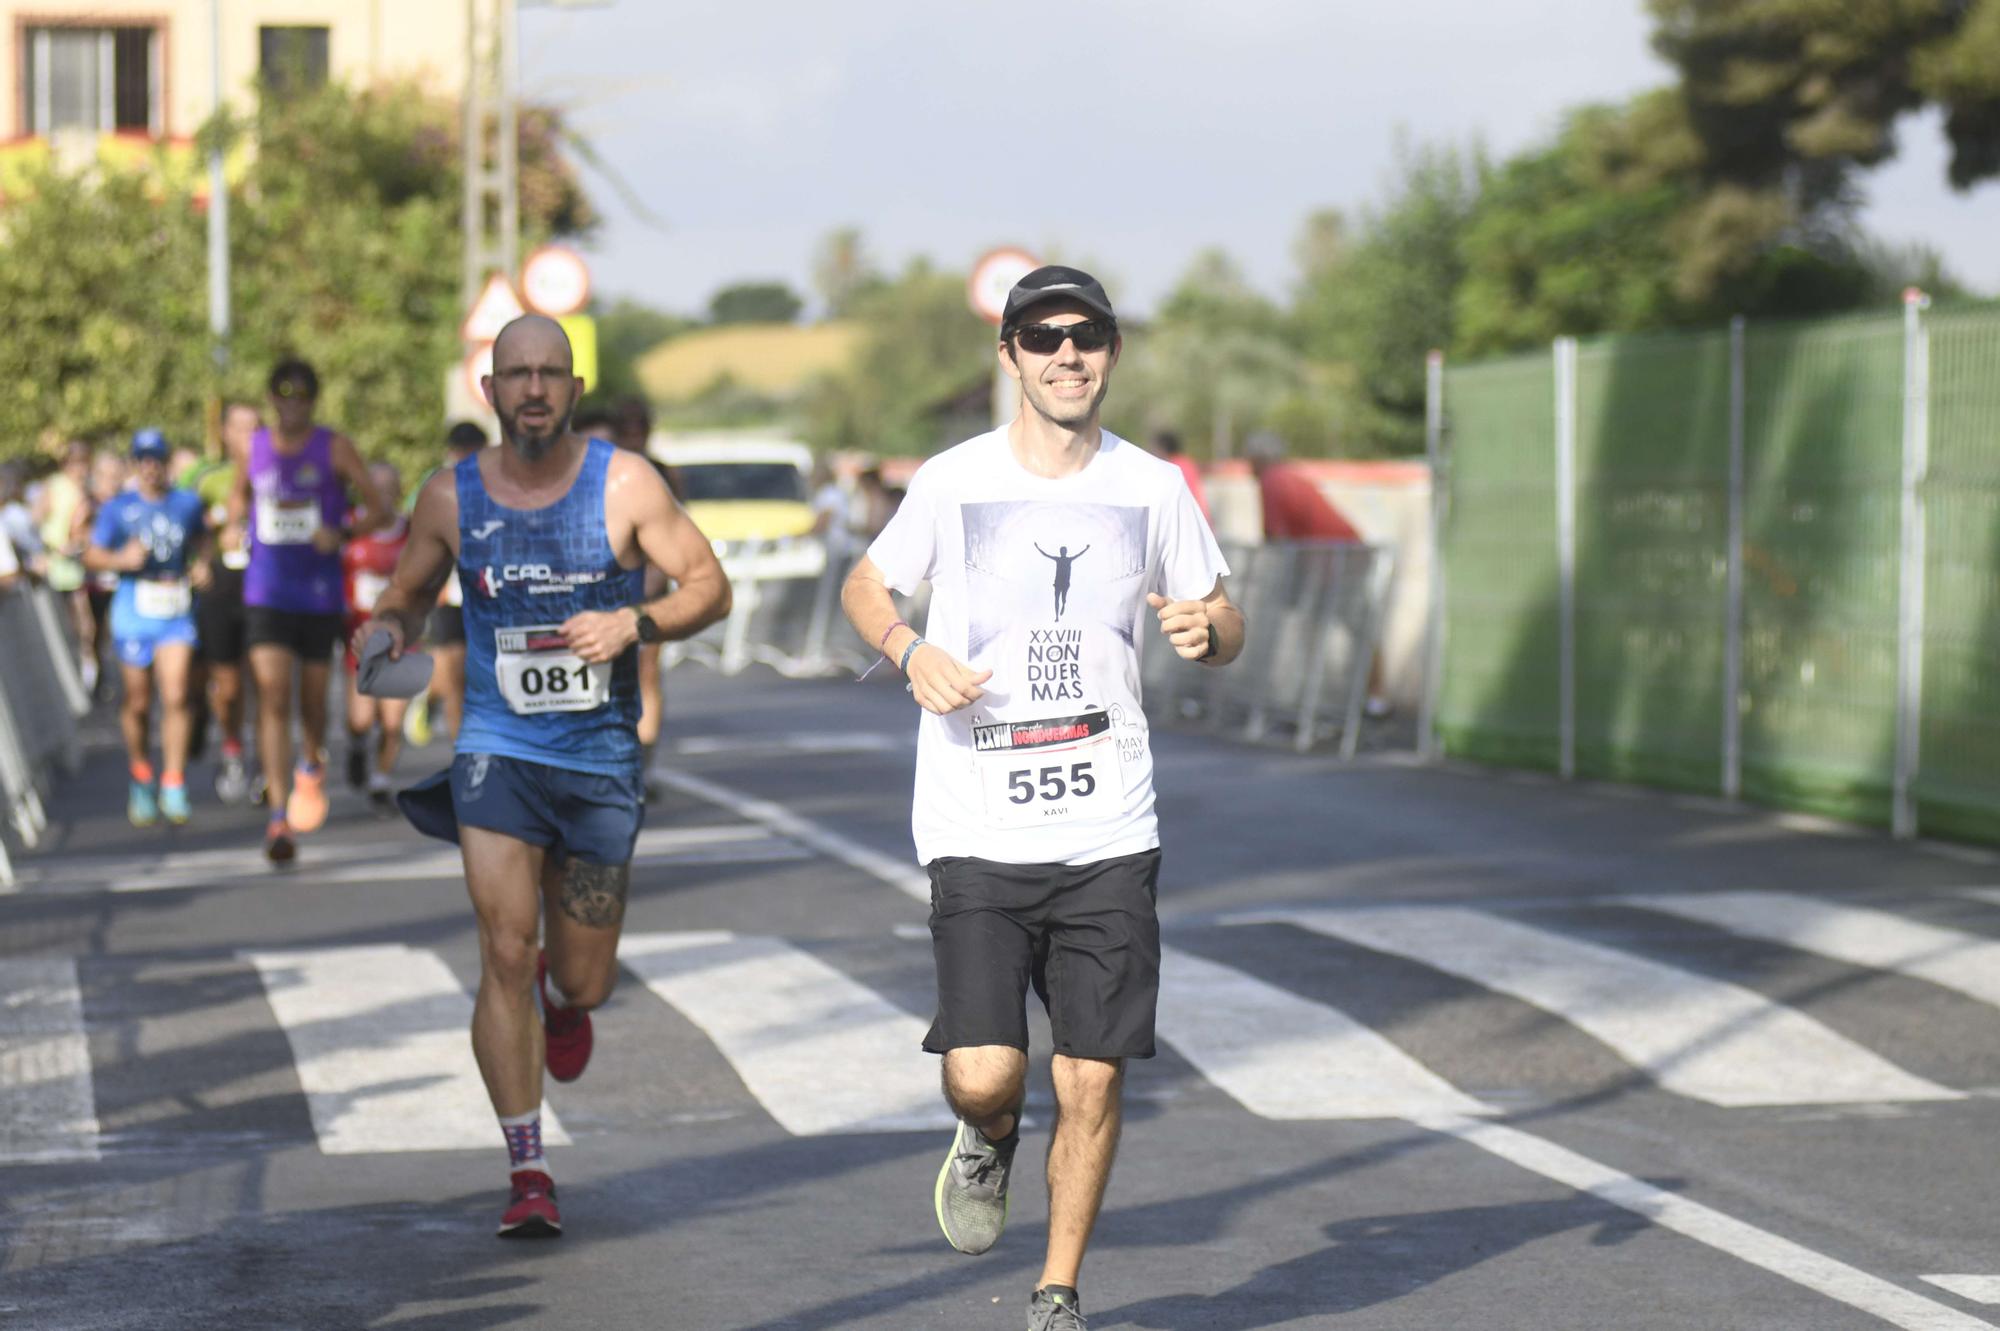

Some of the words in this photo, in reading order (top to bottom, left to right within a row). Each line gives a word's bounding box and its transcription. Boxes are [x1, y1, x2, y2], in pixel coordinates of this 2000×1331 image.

[503, 564, 552, 581] CAD
[1029, 629, 1082, 644] XXVIII
[1027, 643, 1080, 663] NON
[521, 664, 590, 696] 081
[1027, 662, 1081, 682] DUER
[1031, 680, 1083, 701] MAS
[1012, 723, 1090, 746] NONDUERMAS
[1117, 736, 1143, 750] MAY
[1123, 748, 1145, 762] DAY
[1008, 761, 1096, 805] 555
[1043, 808, 1069, 816] XAVI
